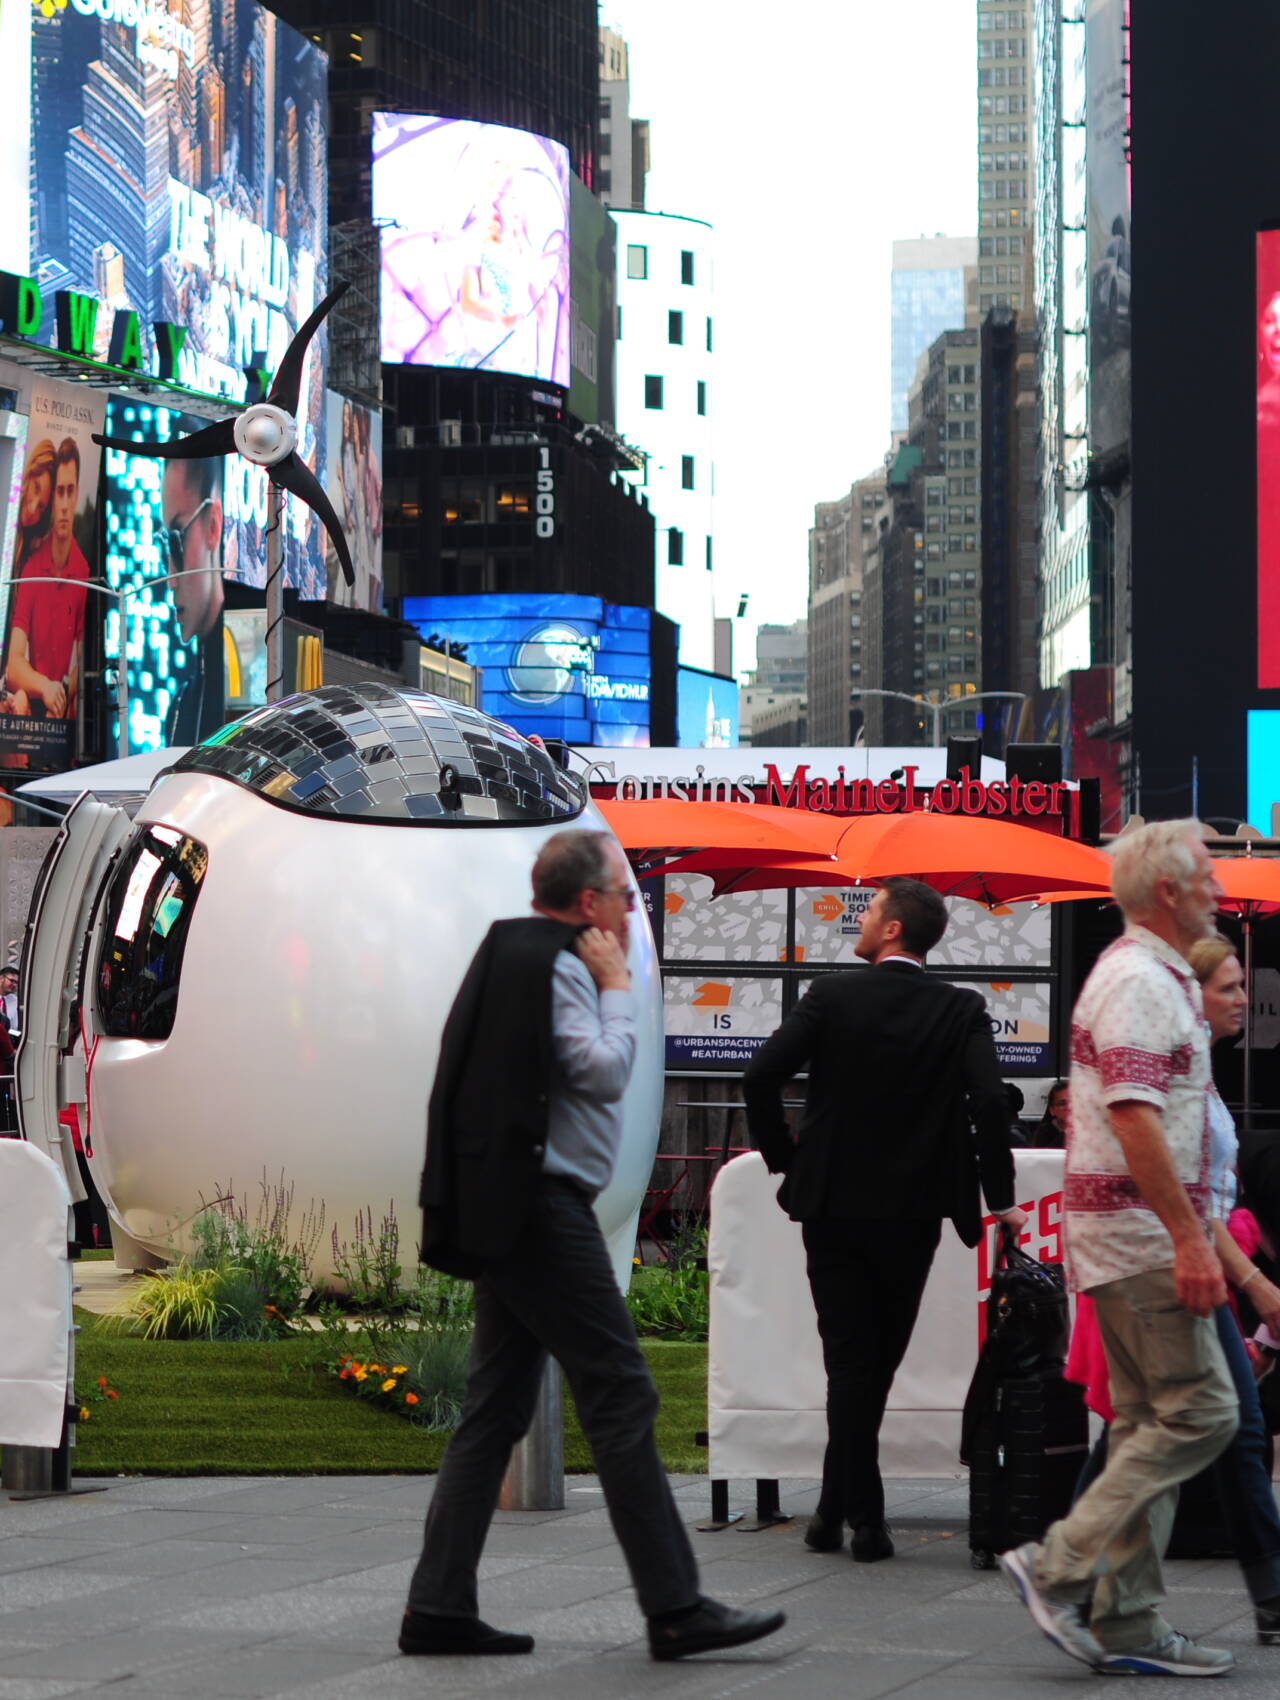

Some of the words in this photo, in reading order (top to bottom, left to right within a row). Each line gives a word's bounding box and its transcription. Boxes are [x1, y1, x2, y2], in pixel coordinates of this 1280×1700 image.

[50, 400, 72, 419] POLO
[535, 447, 555, 538] 1500
[10, 719, 67, 735] AUTHENTICALLY
[582, 761, 757, 807] Cousins
[714, 1013, 731, 1030] IS
[674, 1038, 767, 1049] @URBANSPACENY
[691, 1049, 752, 1060] #EATURBAN
